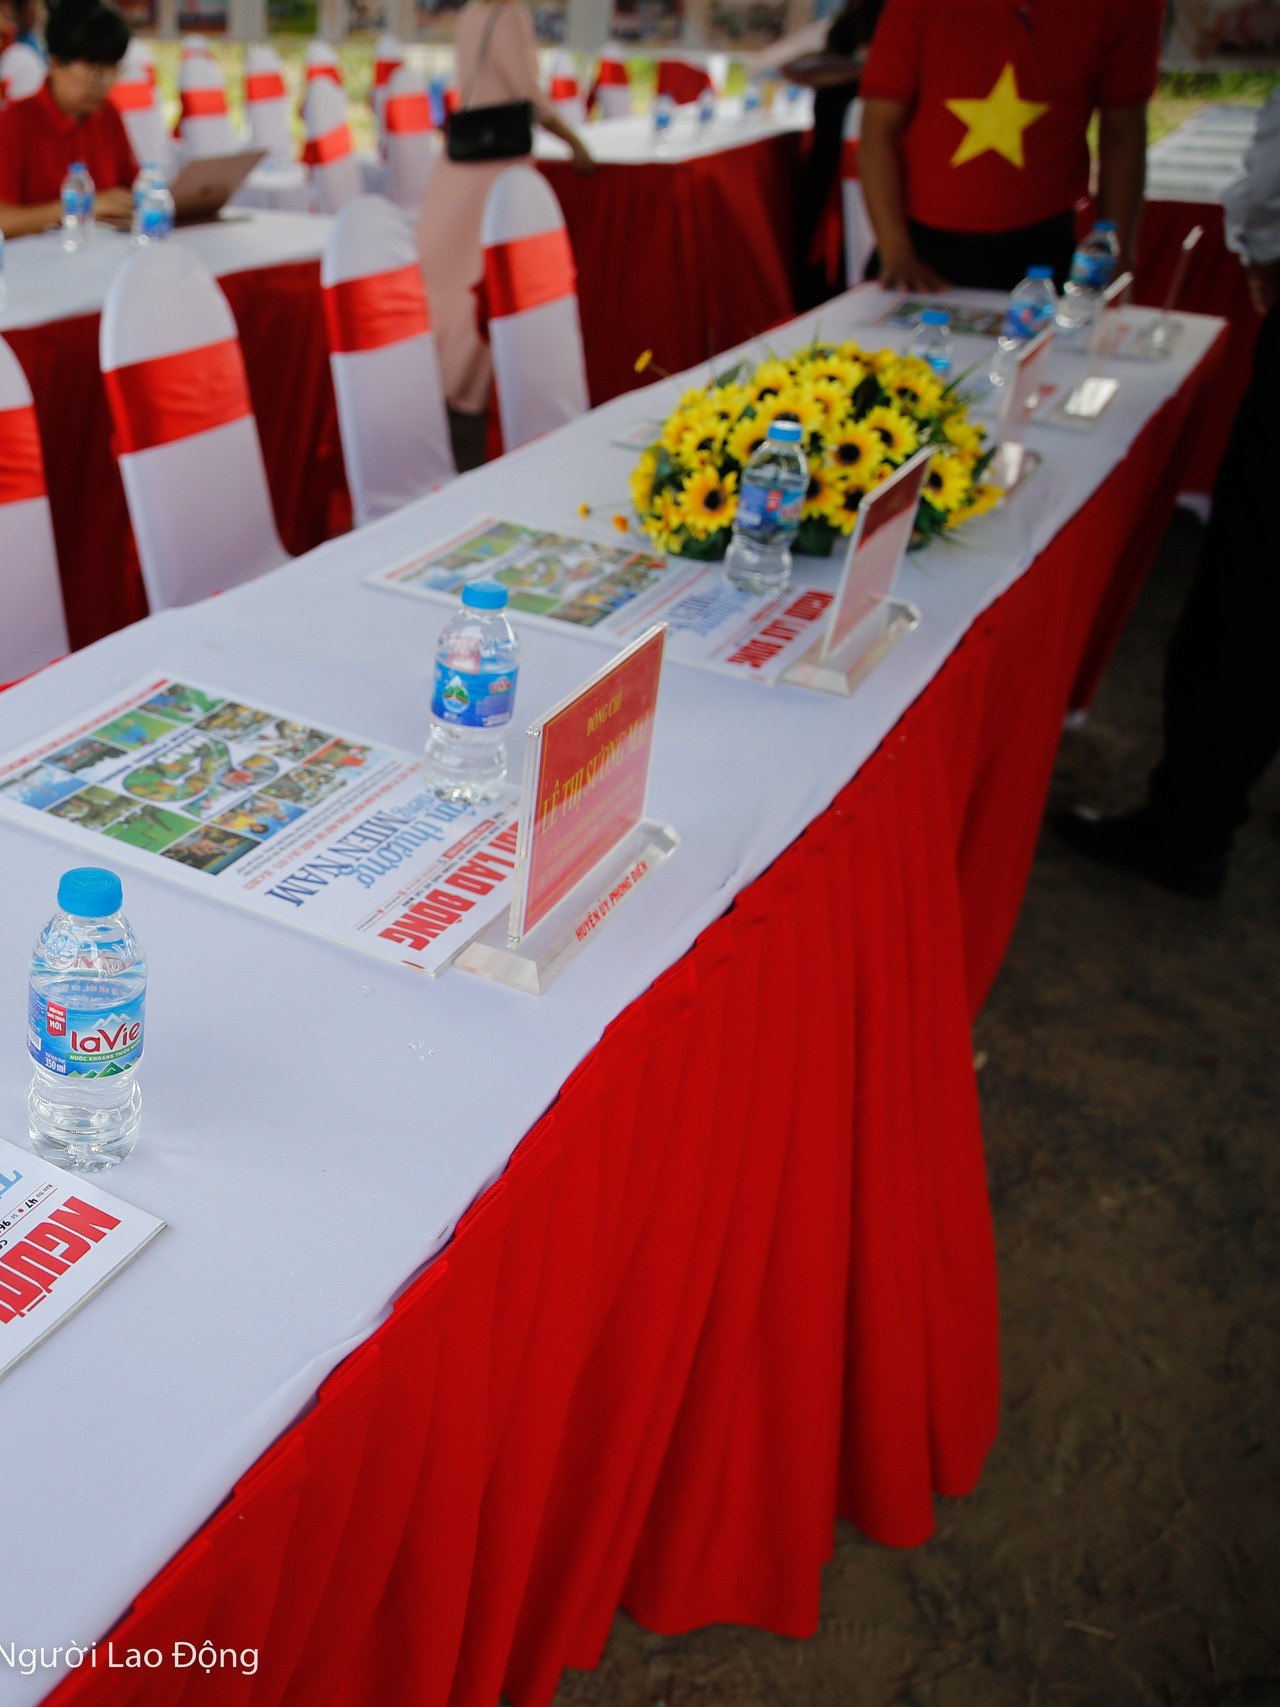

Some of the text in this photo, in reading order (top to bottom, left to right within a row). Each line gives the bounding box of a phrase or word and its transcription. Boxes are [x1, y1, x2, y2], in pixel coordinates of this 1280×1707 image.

[542, 780, 559, 835] LÊ
[562, 767, 584, 816] THỊ
[330, 815, 444, 889] thương
[444, 852, 514, 895] LAO
[265, 855, 353, 907] NAM
[378, 889, 476, 951] ĐỘNG
[45, 1058, 66, 1073] 350 ml
[24, 1198, 38, 1208] 47
